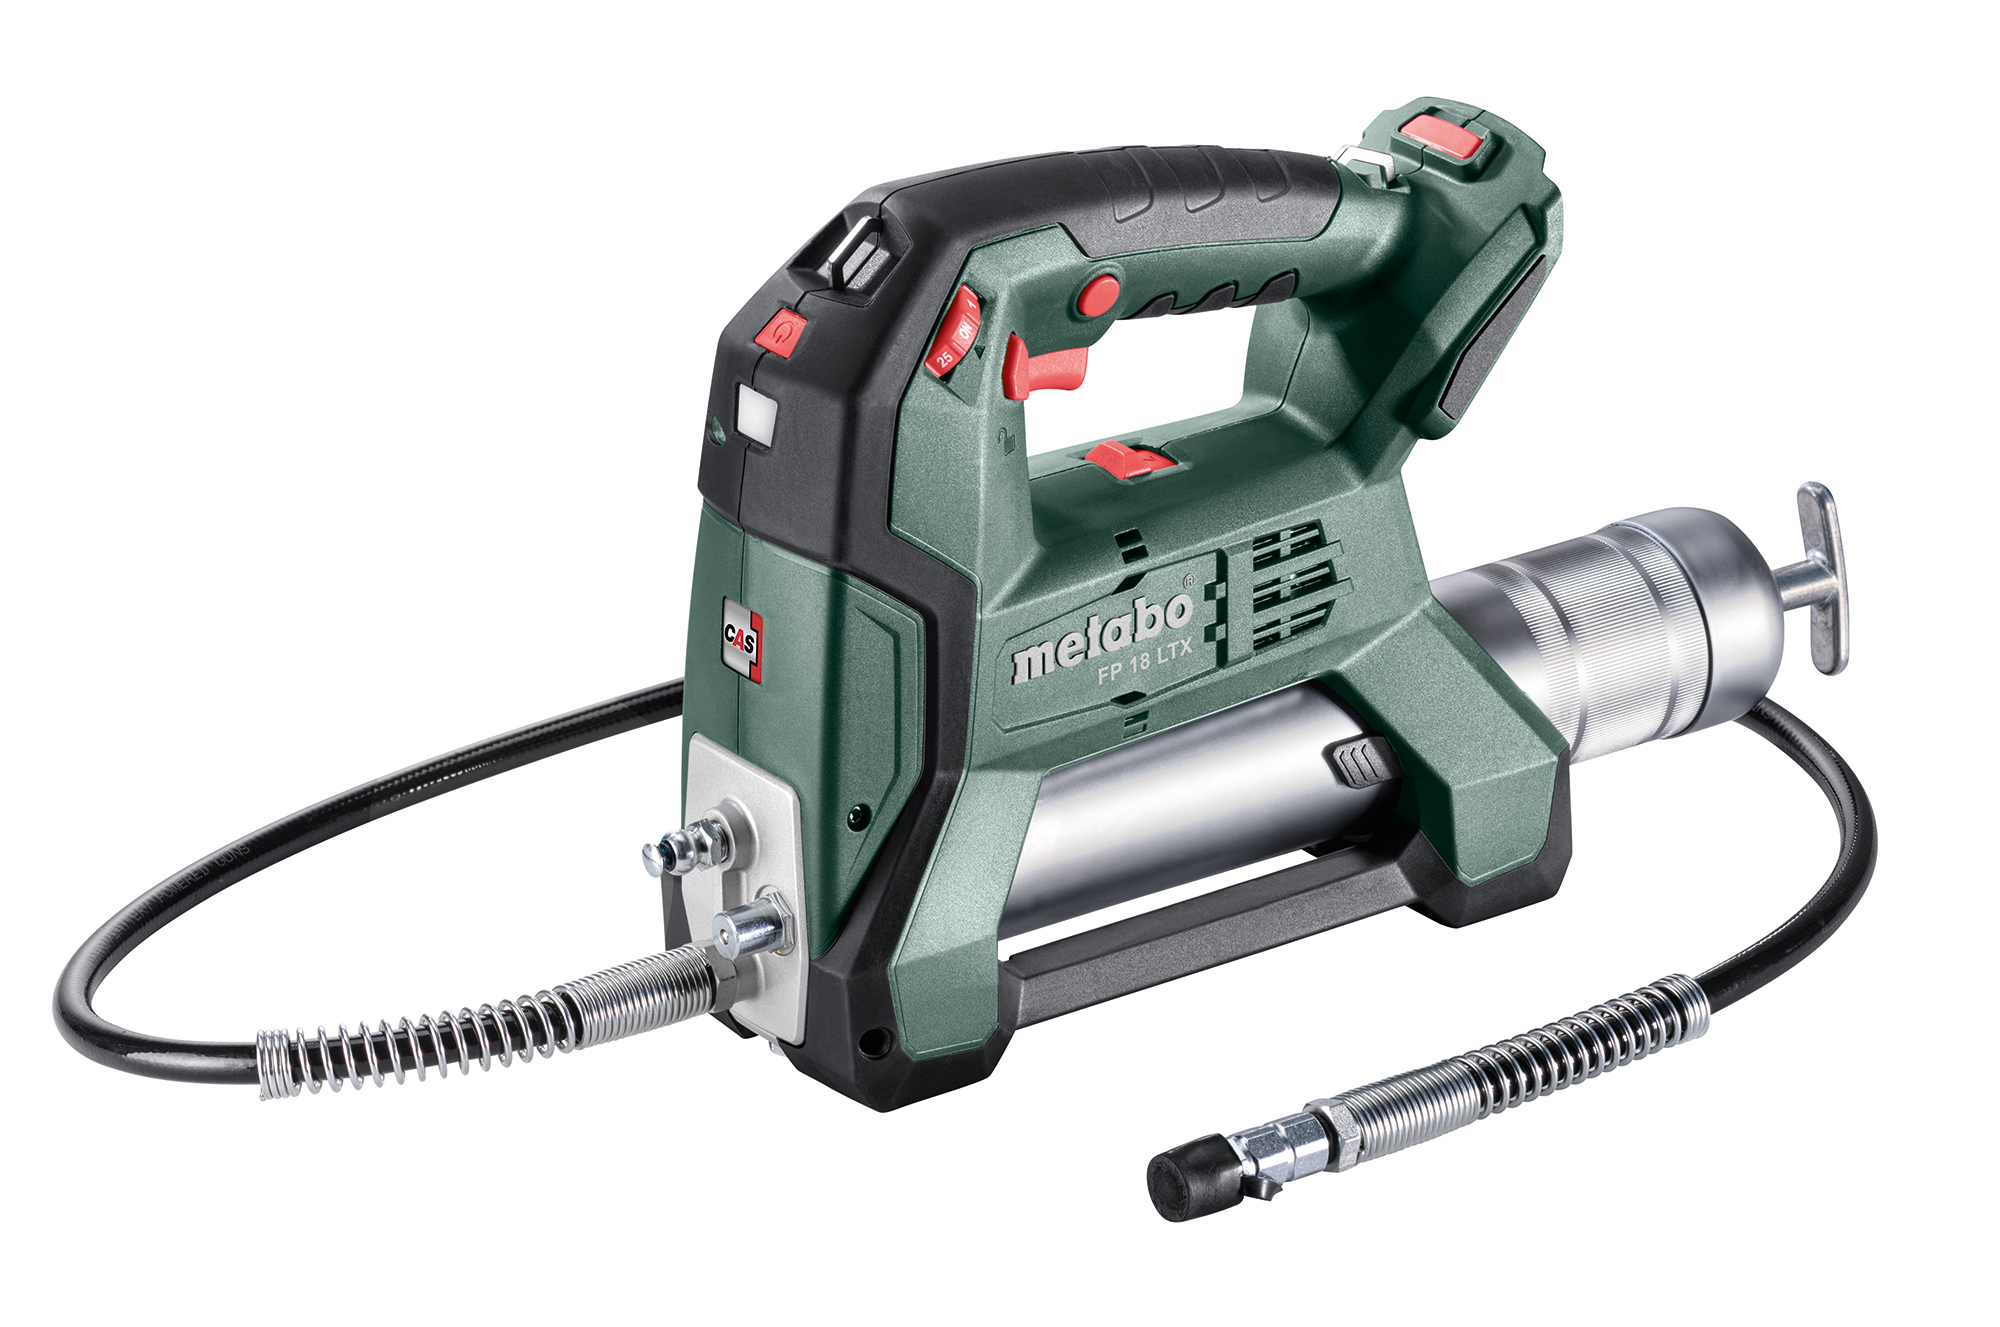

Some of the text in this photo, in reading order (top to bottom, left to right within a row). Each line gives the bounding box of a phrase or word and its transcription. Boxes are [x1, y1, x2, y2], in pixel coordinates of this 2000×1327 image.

[966, 299, 977, 309] 1
[958, 321, 973, 340] ON
[936, 351, 953, 368] 25
[724, 623, 755, 654] CAS
[1098, 636, 1193, 685] FP 18 LTX
[156, 865, 210, 903] POWERED
[215, 843, 251, 867] GUNS
